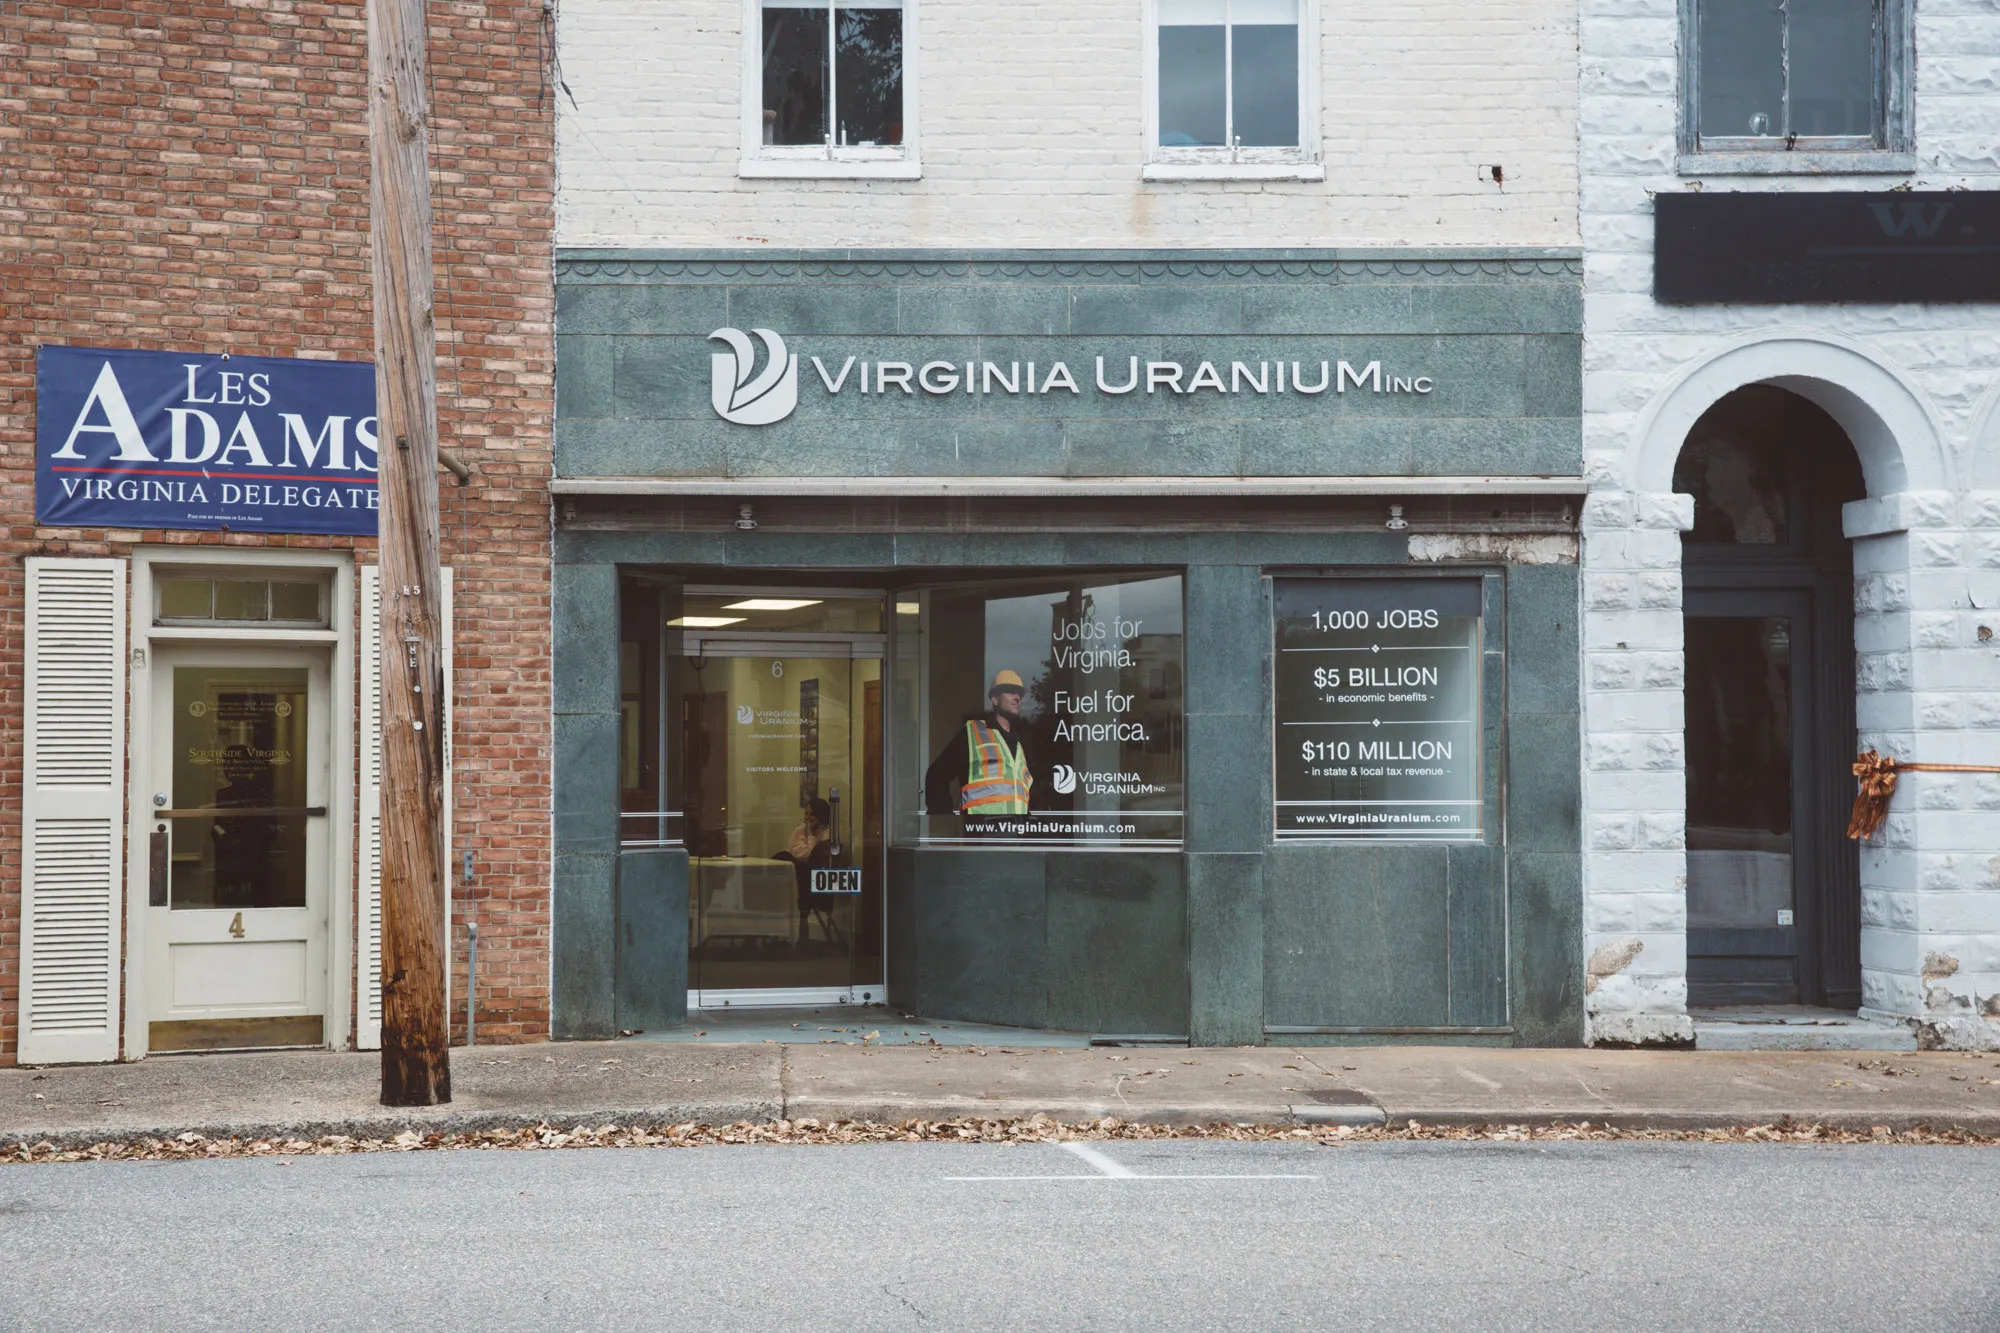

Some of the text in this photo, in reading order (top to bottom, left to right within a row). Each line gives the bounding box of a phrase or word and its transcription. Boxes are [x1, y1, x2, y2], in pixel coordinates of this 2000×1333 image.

[182, 364, 271, 407] LES
[811, 355, 1432, 394] VIRGINIA URANIUM INC
[51, 360, 378, 472] ADAMS
[60, 478, 379, 509] VIRGINIA DELEGATE
[1052, 615, 1142, 641] Jobs for
[1312, 609, 1438, 632] 1,000 JOBS
[772, 661, 783, 677] 6
[1052, 645, 1136, 674] Virginia.
[1314, 667, 1437, 689] $5 BILLION
[1055, 690, 1134, 713] Fuel for
[1327, 694, 1334, 702] in
[1338, 693, 1385, 702] economic
[1389, 693, 1427, 701] benefits
[760, 716, 808, 725] URANIUM
[1054, 719, 1149, 741] America.
[246, 748, 291, 758] VIRGINIA
[1302, 740, 1452, 762] $110 MILLION
[1078, 771, 1142, 783] VIRGINIA
[1312, 767, 1320, 775] in
[1351, 767, 1357, 775] &
[1361, 767, 1383, 775] local
[1085, 783, 1153, 794] URANIUM
[966, 822, 1135, 834] www.VirginiaUranium.com
[1296, 813, 1460, 825] www.VirginiaUranium.com
[816, 871, 858, 890] OPEN
[228, 912, 246, 938] 4
